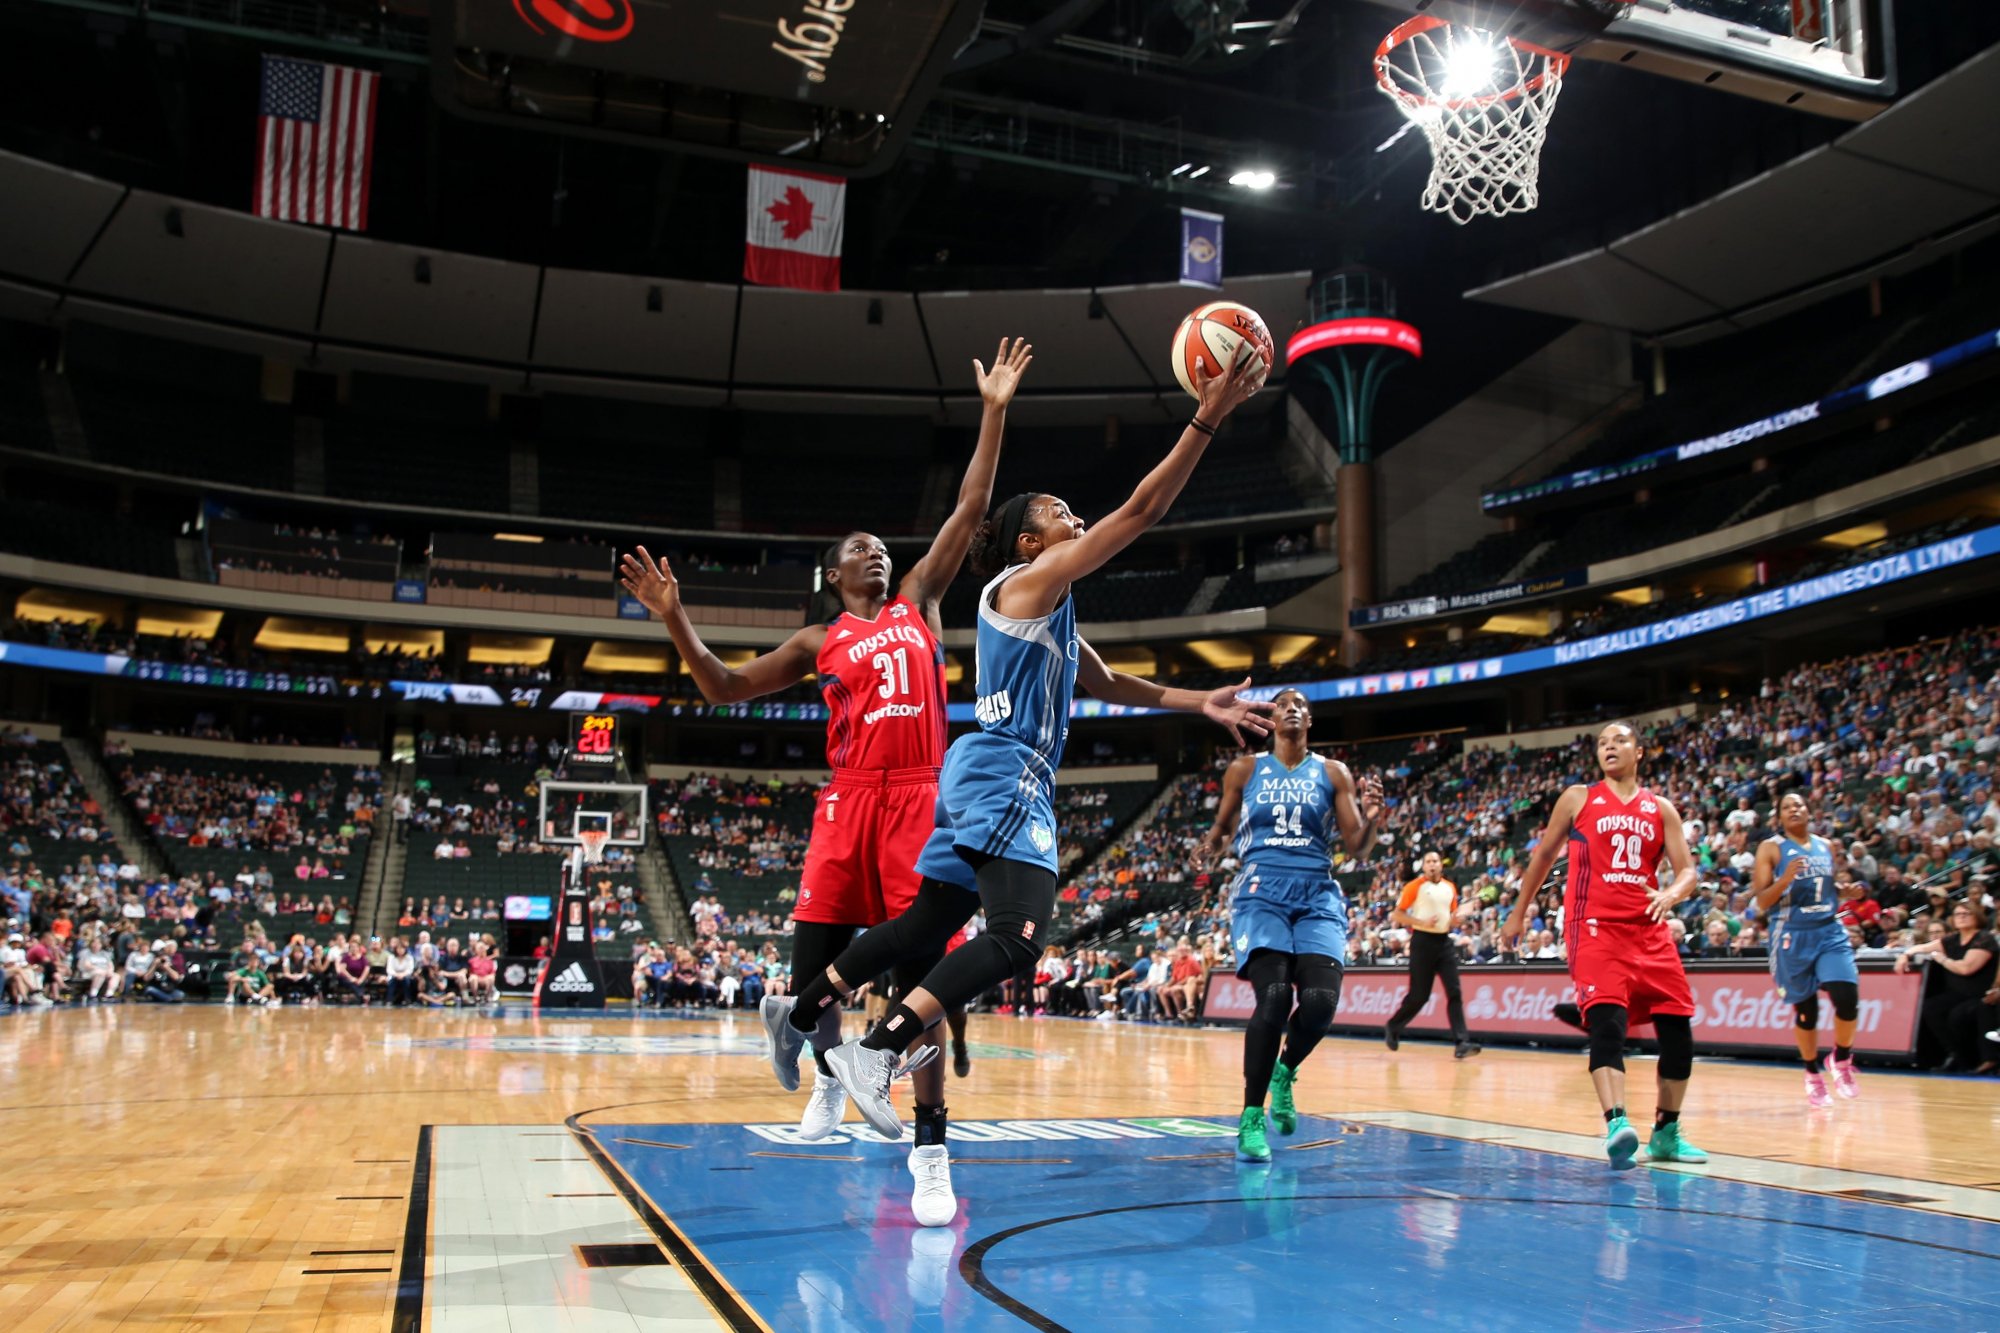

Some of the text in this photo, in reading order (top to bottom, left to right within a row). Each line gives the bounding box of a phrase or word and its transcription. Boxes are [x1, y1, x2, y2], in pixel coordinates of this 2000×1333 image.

[1677, 401, 1821, 460] MINNESOTA LYNX
[1383, 602, 1407, 619] RBC
[1451, 584, 1523, 607] Management
[1555, 535, 1975, 664] NATURALLY POWERING THE MINNESOTA LYNX
[848, 625, 925, 663] mystics
[873, 647, 910, 699] 31
[864, 702, 921, 724] verizon
[578, 729, 611, 754] 20
[1262, 778, 1316, 792] MAYO
[1256, 790, 1319, 807] CLINIC
[1272, 804, 1302, 836] 34
[1596, 814, 1656, 842] mystics
[1264, 836, 1310, 847] verizon
[1813, 877, 1824, 902] 1
[549, 981, 594, 992] adidas
